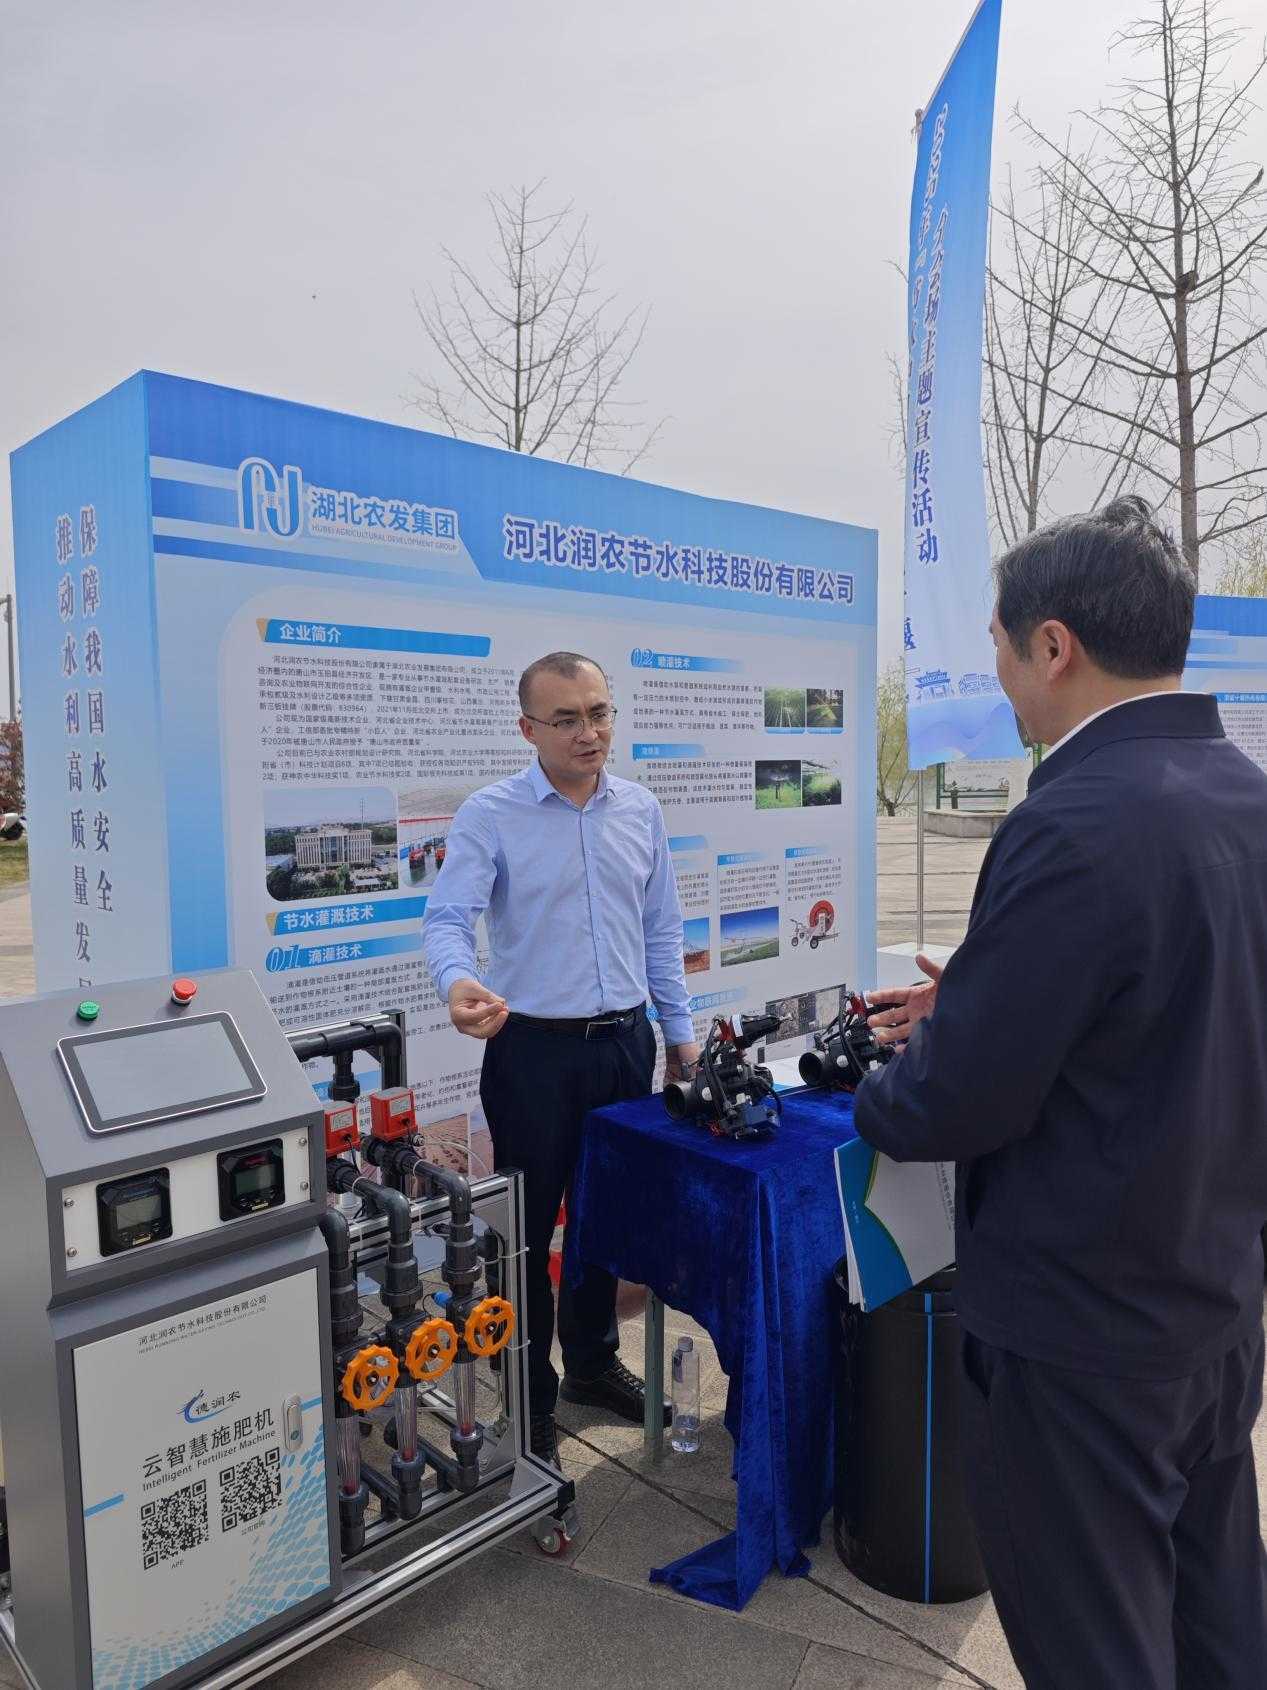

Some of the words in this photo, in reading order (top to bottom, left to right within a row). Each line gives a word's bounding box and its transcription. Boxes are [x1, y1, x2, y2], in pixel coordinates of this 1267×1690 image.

[312, 490, 456, 540] 湖北农发集团
[505, 517, 855, 604] 河北润农节水科技股份有限公司
[279, 622, 342, 644] 企业简介
[81, 504, 113, 912] 保障我国水安全
[283, 904, 375, 930] 节水灌溉技术
[307, 944, 363, 965] 滴灌技术
[139, 1295, 268, 1346] 河北润农节水科技股份有限公司
[142, 1408, 274, 1479] 云智慧施肥机
[142, 1464, 193, 1492] Intelligent
[197, 1446, 237, 1469] Fertilizer
[239, 1429, 276, 1451] Machine
